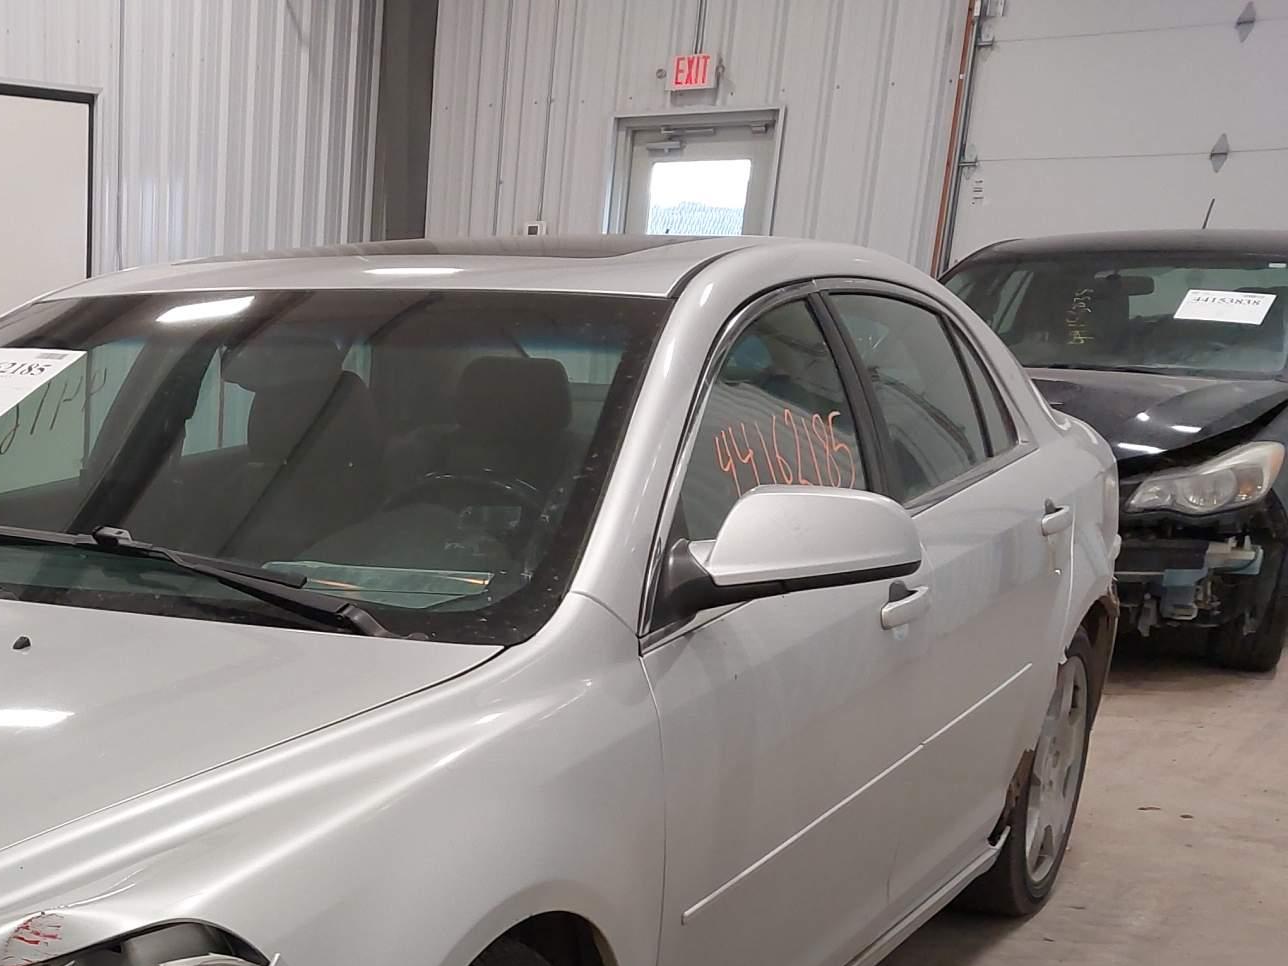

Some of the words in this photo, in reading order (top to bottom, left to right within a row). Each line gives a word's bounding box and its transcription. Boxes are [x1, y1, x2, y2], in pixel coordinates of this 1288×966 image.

[675, 55, 710, 85] EXIT
[1192, 296, 1262, 305] 44153838
[715, 408, 857, 497] 44162185
